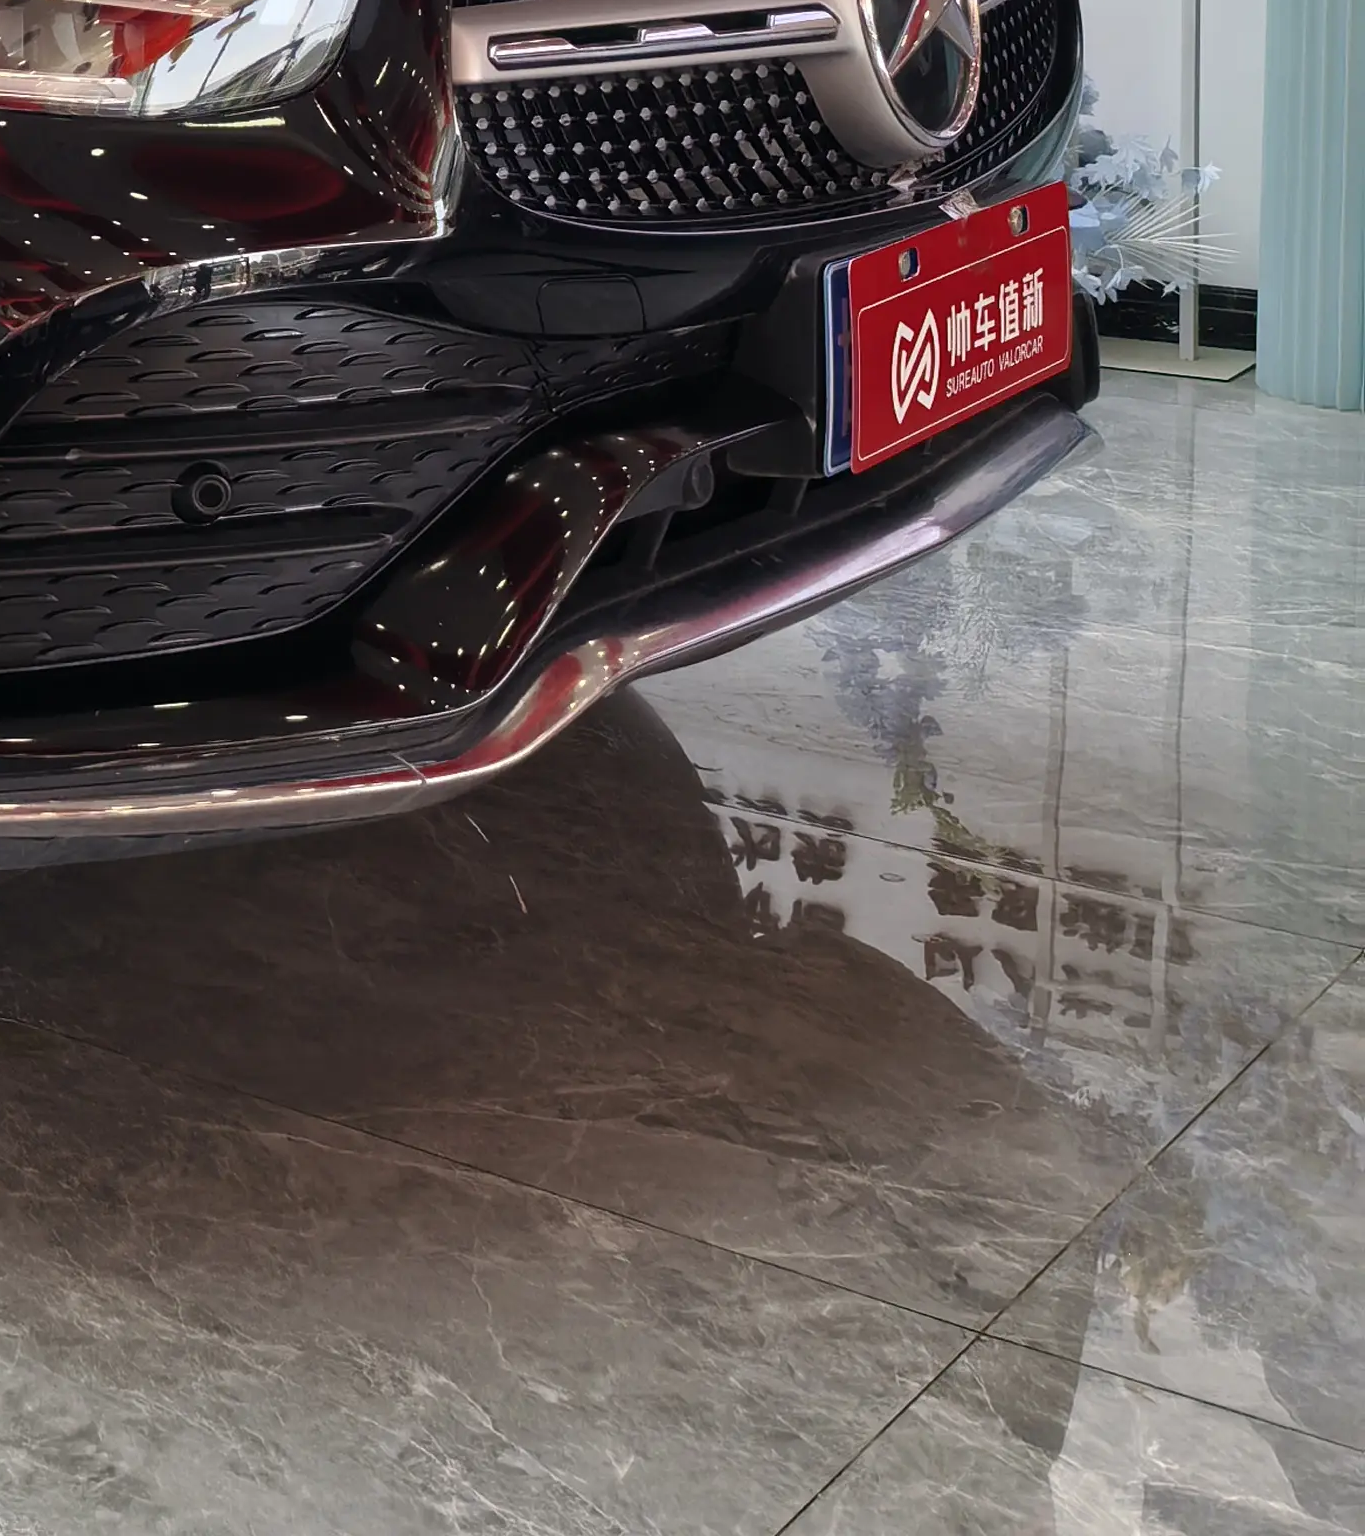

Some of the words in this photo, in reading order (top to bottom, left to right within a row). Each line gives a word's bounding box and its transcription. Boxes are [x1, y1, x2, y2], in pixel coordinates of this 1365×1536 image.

[946, 267, 1044, 367] 帅车值新
[945, 359, 995, 398] SUREAUTO
